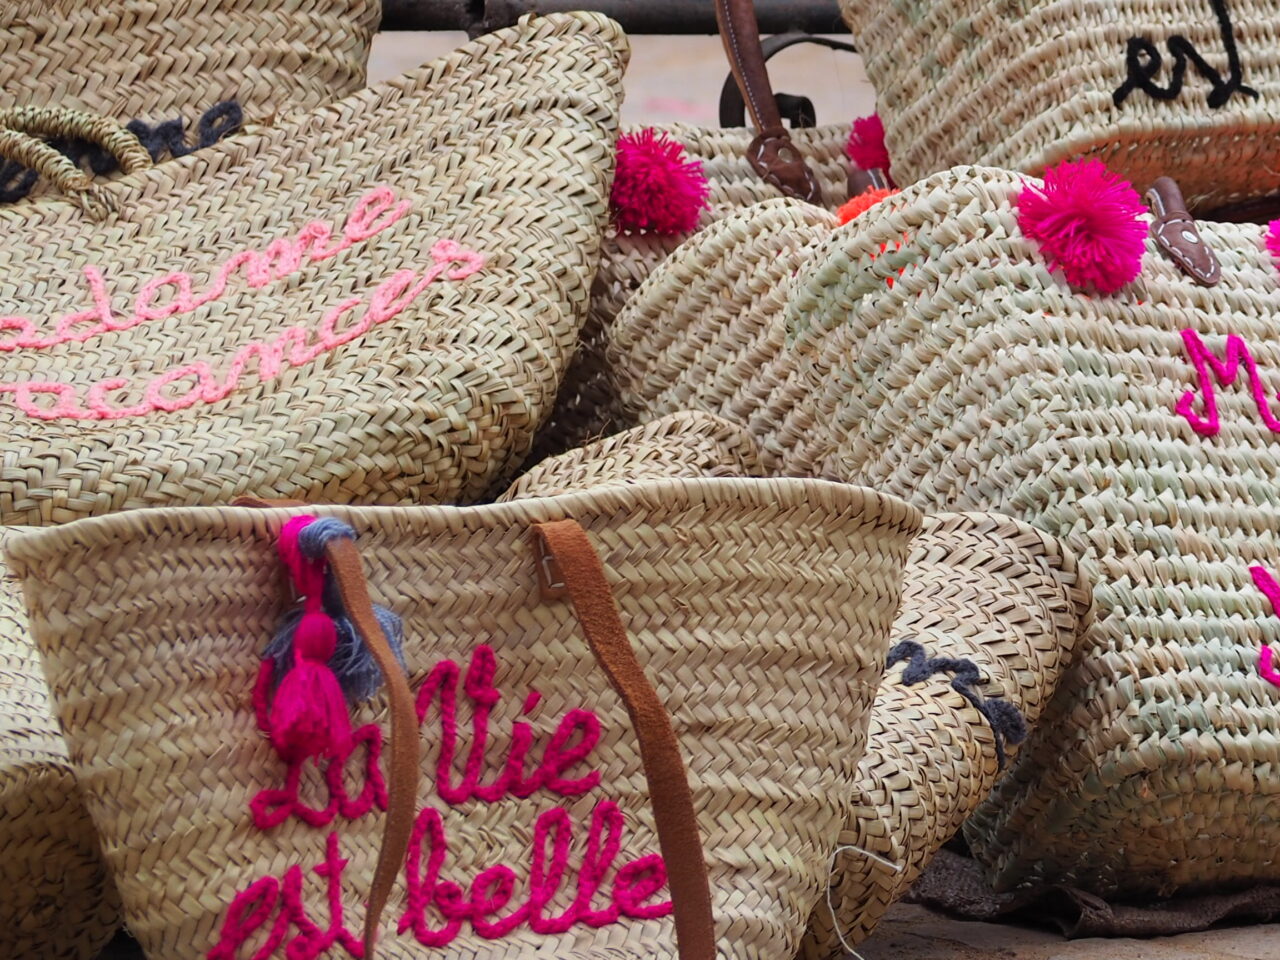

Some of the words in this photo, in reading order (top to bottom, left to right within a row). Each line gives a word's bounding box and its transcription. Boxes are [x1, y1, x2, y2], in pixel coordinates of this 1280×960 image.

[0, 240, 486, 421] acances
[205, 830, 372, 960] est
[396, 797, 678, 949] belle
